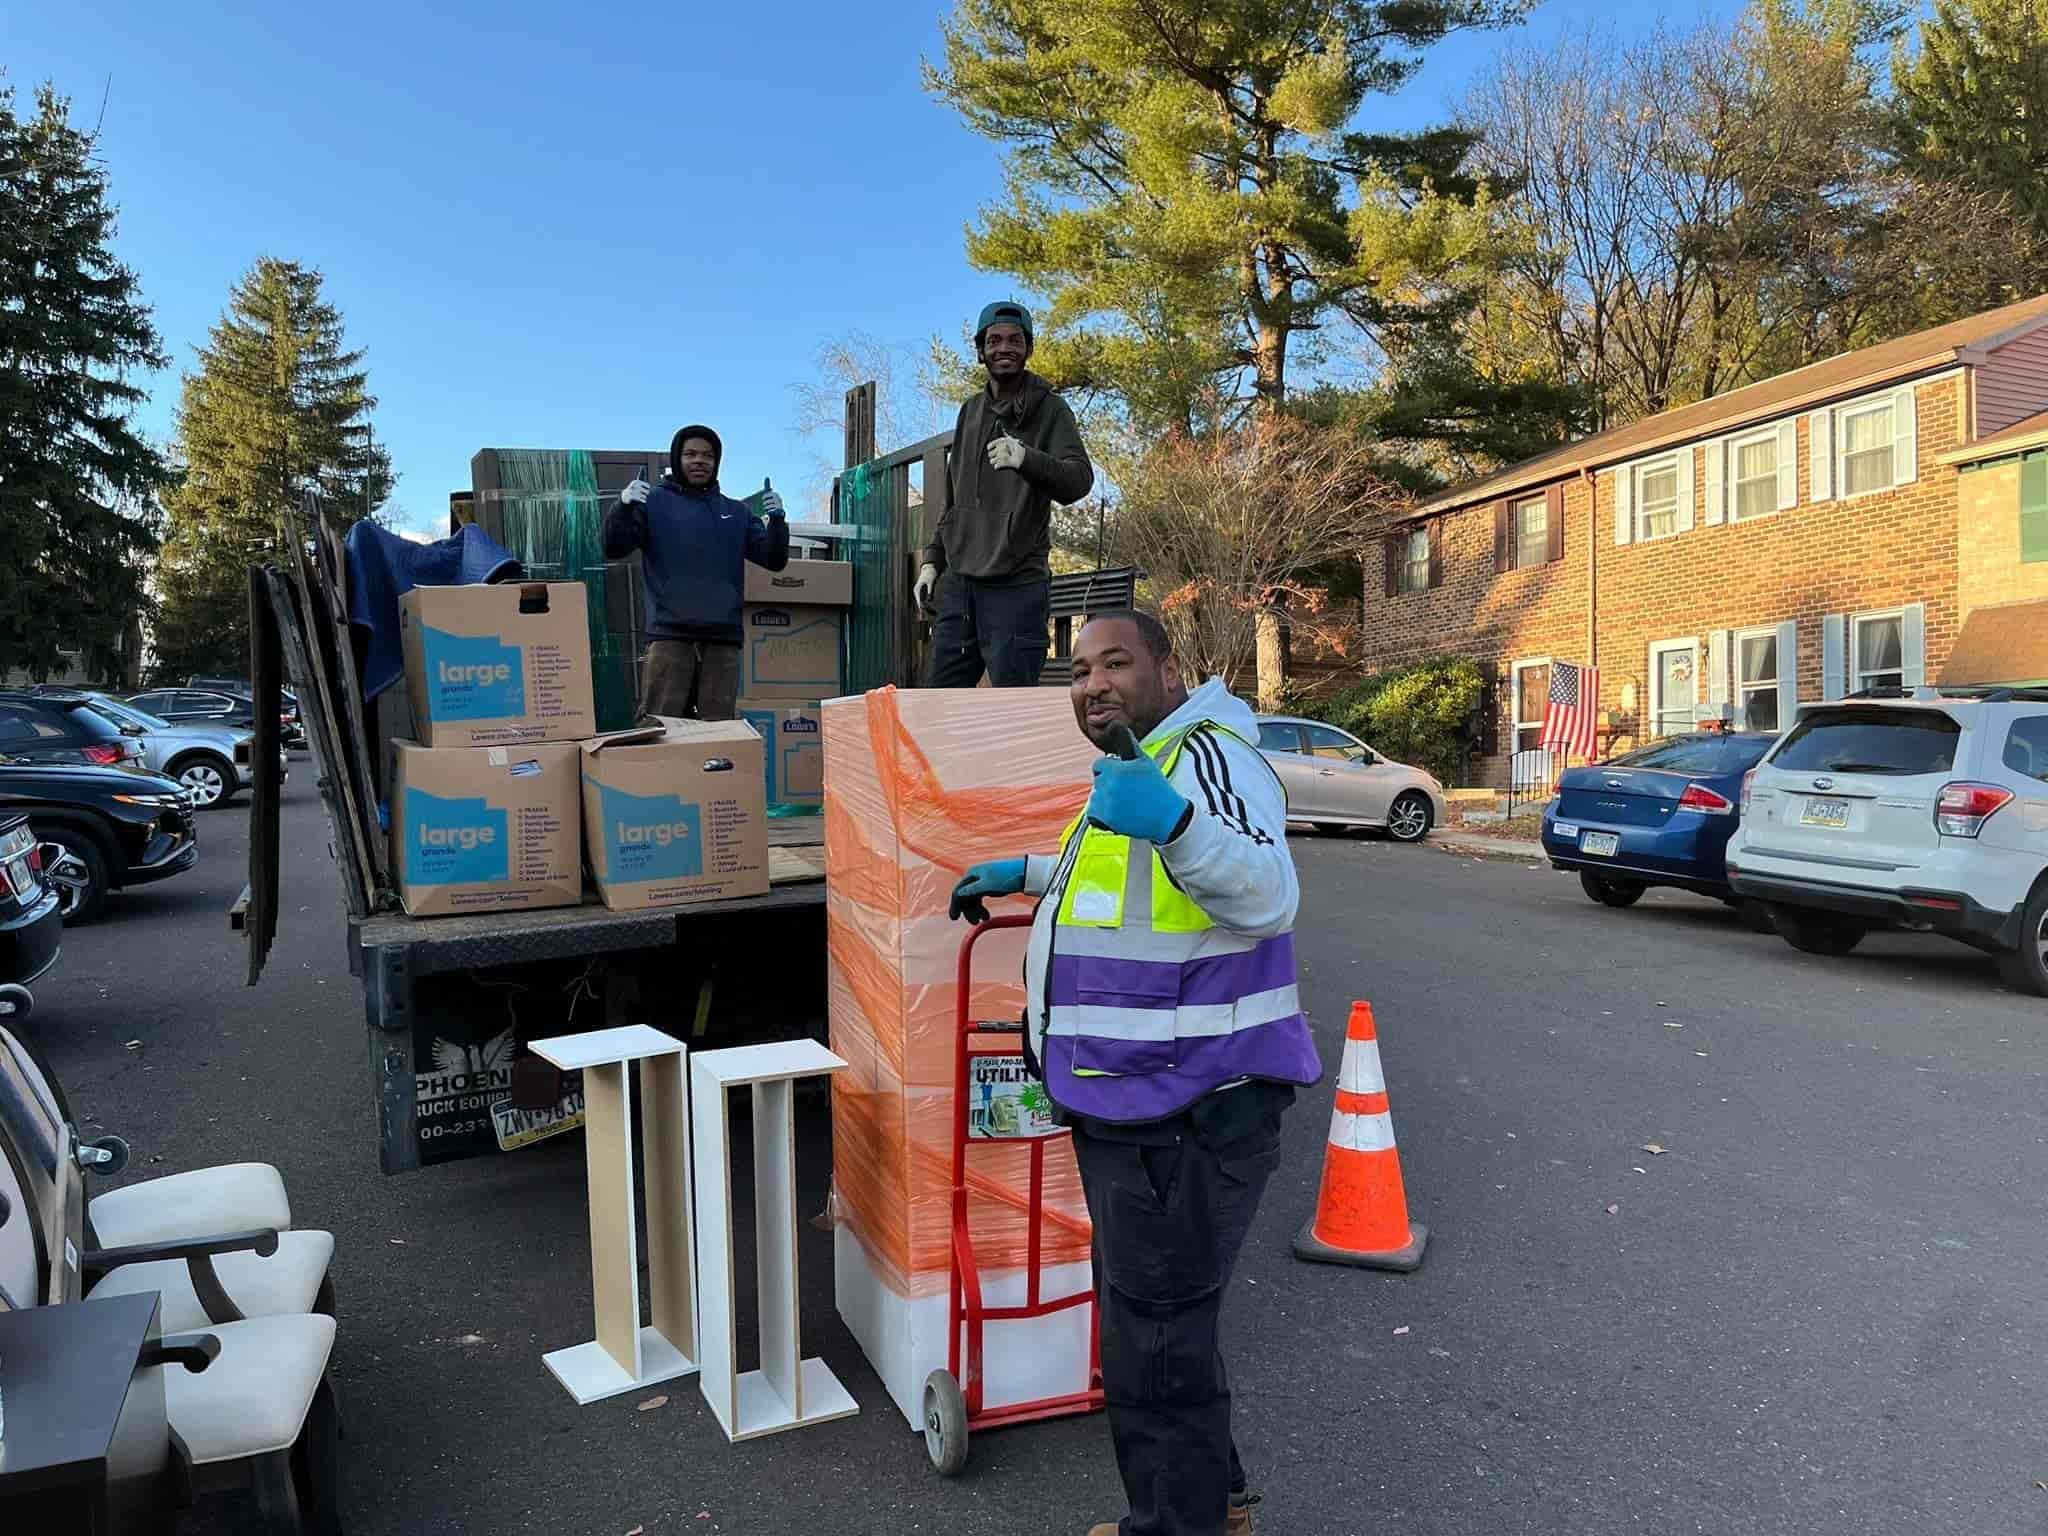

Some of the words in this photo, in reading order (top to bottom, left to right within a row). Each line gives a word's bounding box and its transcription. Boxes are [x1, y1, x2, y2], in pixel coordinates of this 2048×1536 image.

[439, 660, 511, 687] large
[420, 823, 496, 848] large
[617, 820, 689, 848] large
[976, 1067, 1030, 1082] UTILIT
[1000, 1058, 1024, 1066] PRO-SE
[416, 1069, 512, 1094] PHOEN
